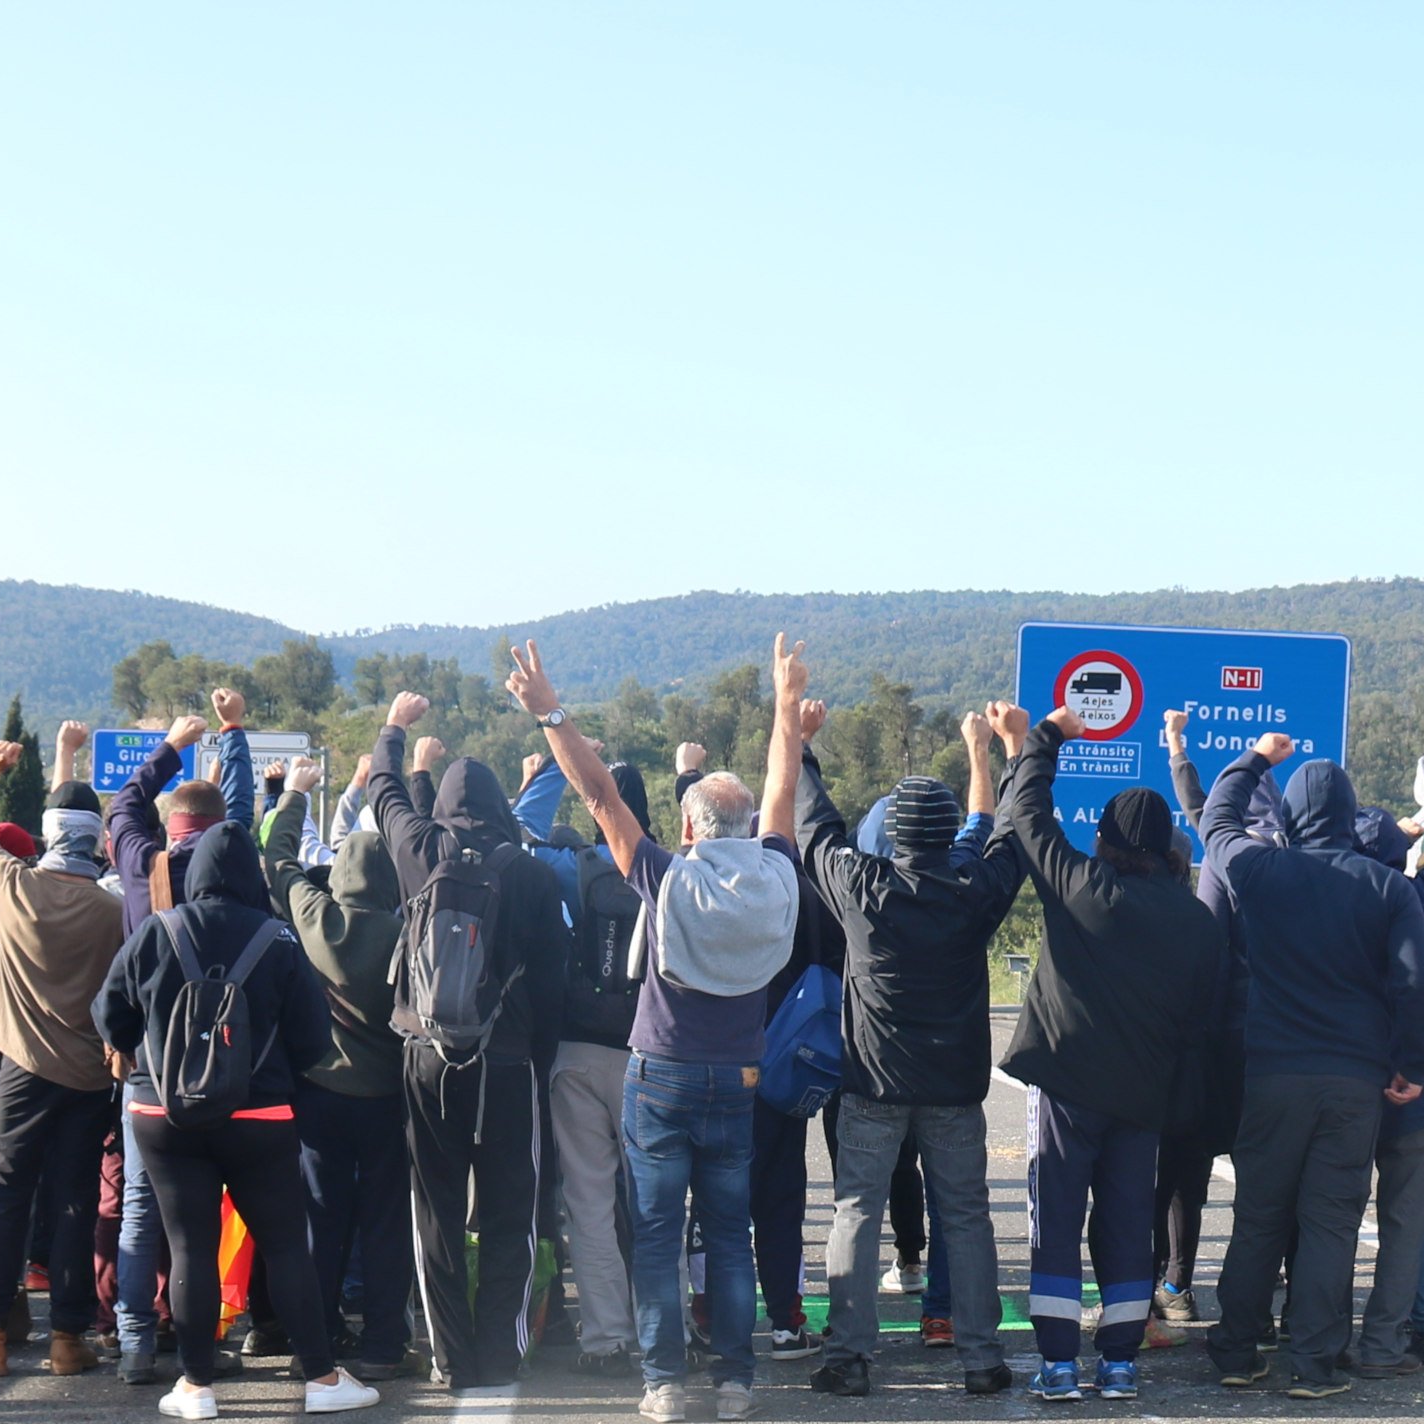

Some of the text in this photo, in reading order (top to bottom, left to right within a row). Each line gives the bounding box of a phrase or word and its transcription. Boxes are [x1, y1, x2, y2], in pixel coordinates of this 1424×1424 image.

[1225, 670, 1259, 687] N-II
[1081, 696, 1113, 708] 4 ejes
[1088, 709, 1116, 720] eixos
[1184, 700, 1287, 723] Fornells
[1198, 731, 1314, 754] Jonqra
[119, 749, 151, 762] Giro
[1058, 743, 1135, 757] En tránsito
[1060, 760, 1130, 773] En trànsit
[602, 920, 616, 977] Quechua
